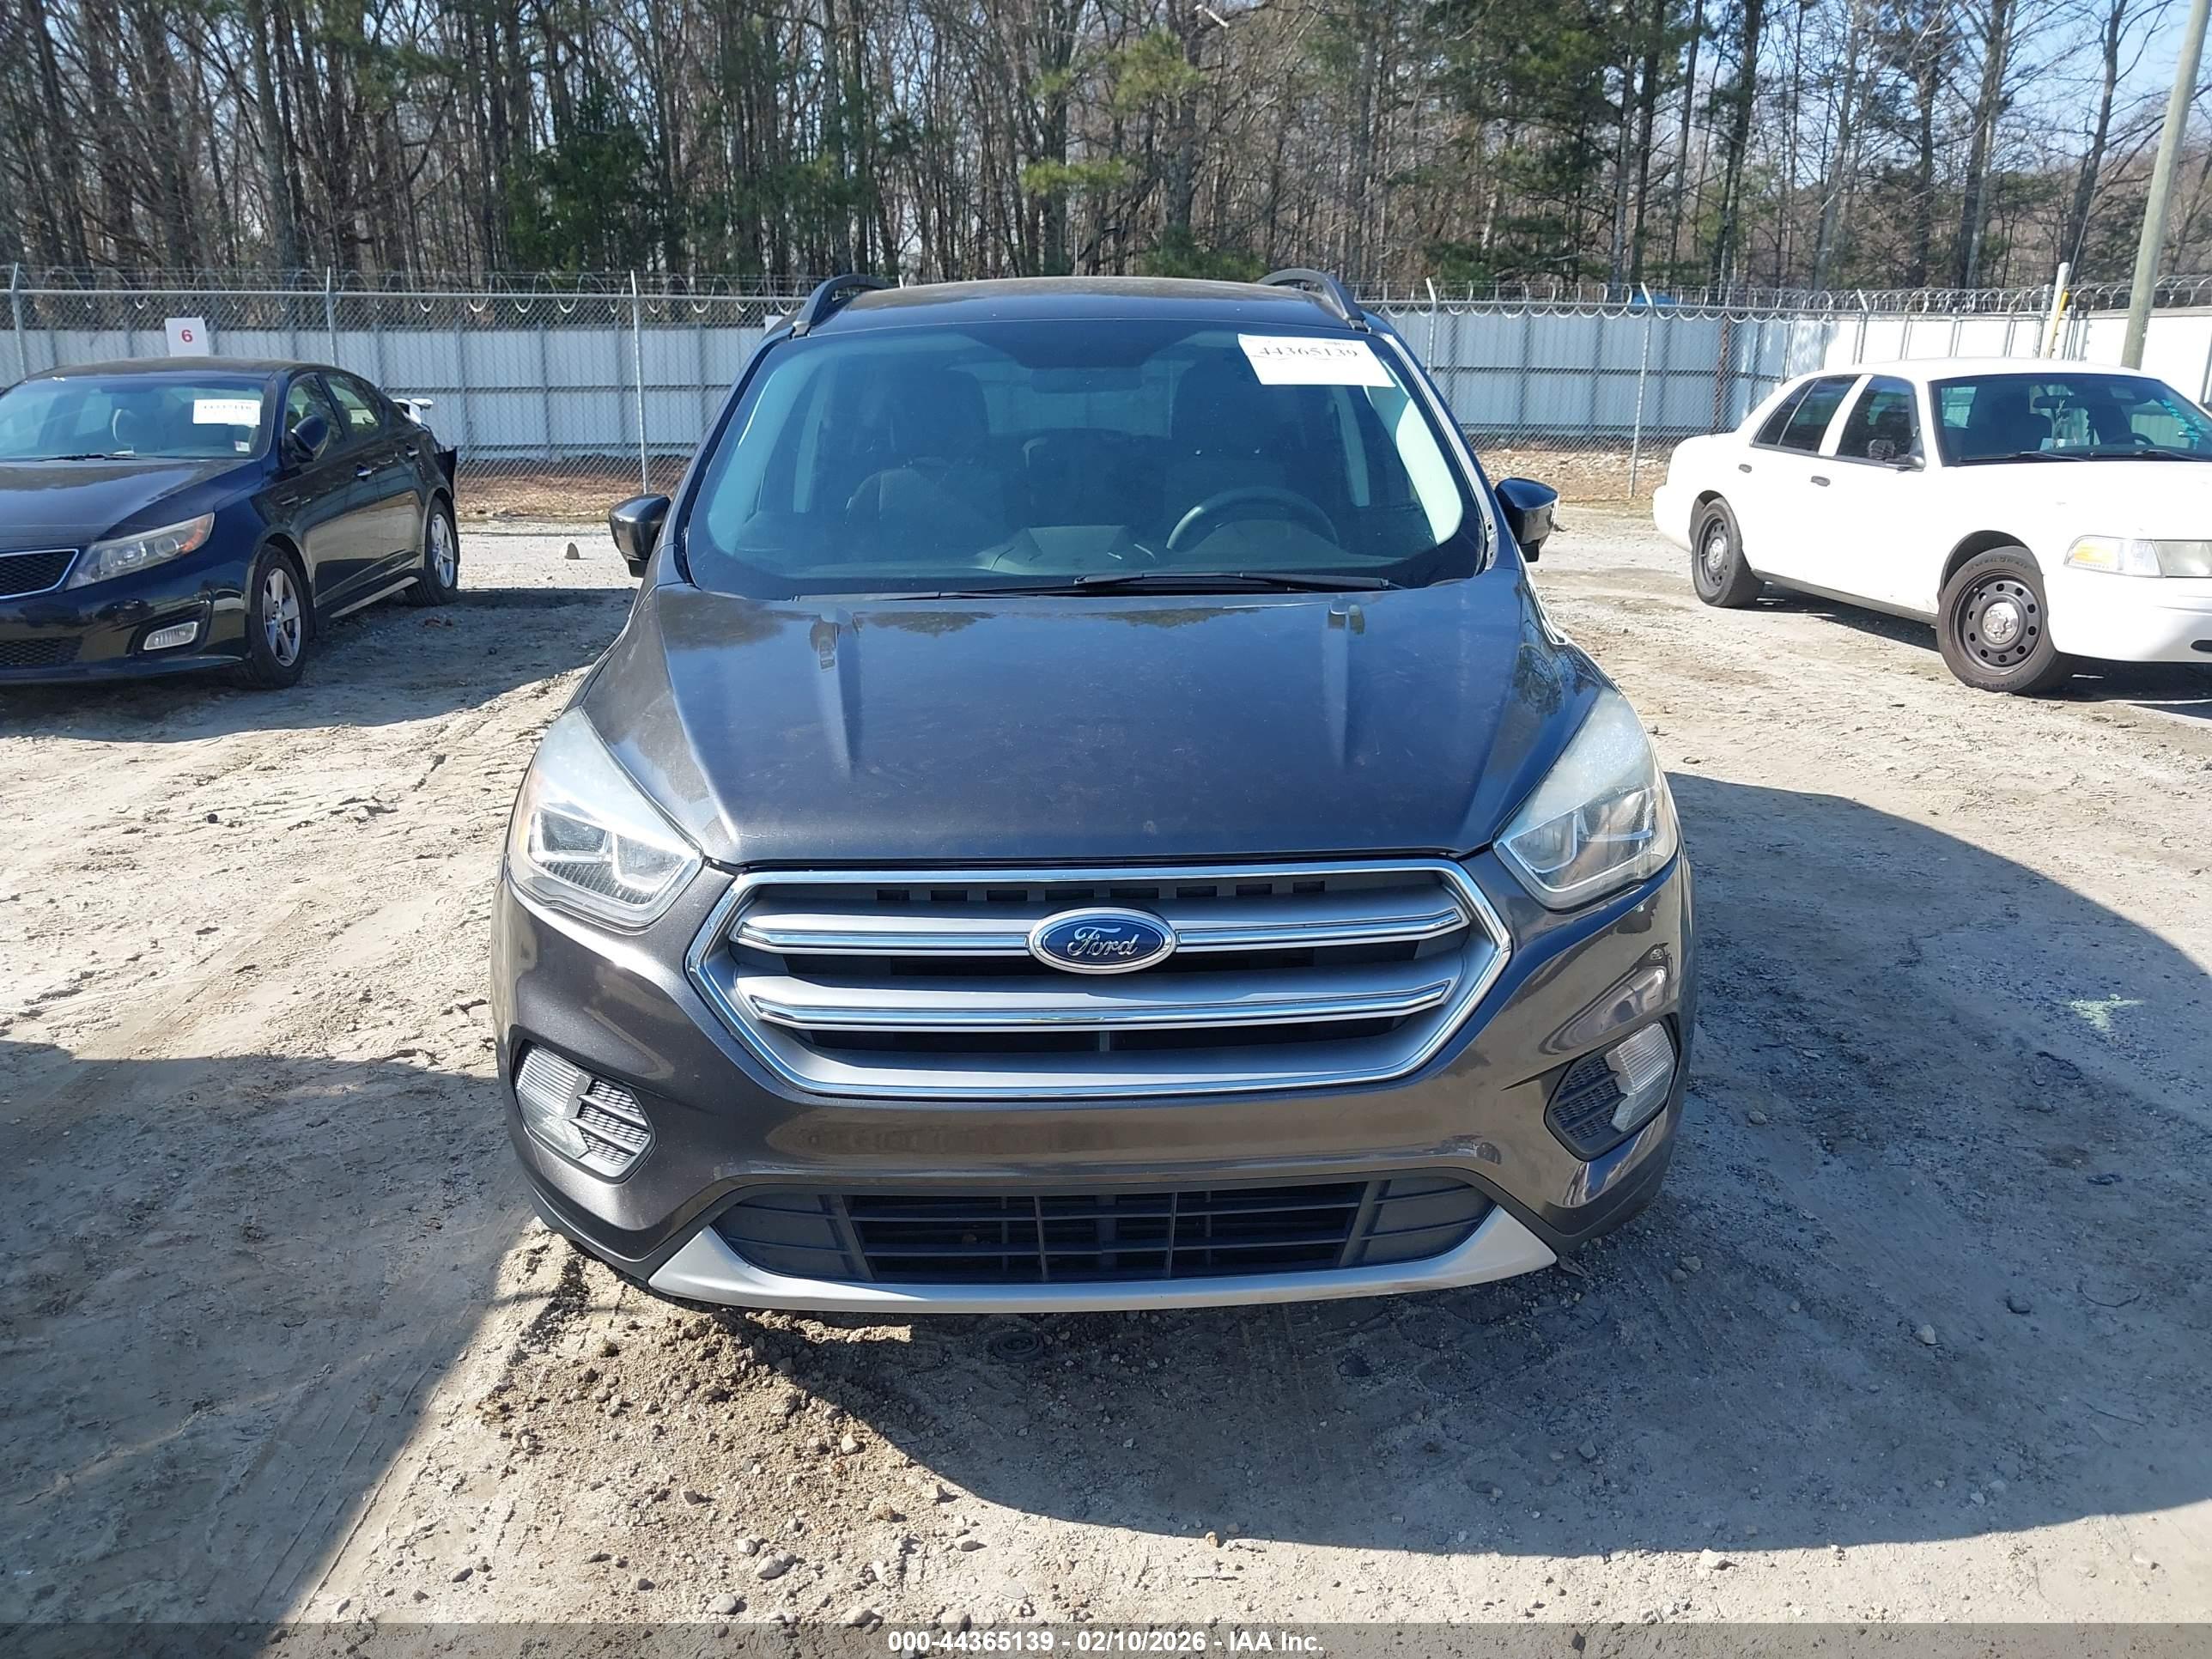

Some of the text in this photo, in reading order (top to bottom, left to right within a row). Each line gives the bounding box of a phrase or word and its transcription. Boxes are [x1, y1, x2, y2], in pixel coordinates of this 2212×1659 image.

[181, 329, 193, 343] 6
[1259, 346, 1358, 357] 44365139
[1066, 926, 1140, 957] Ford
